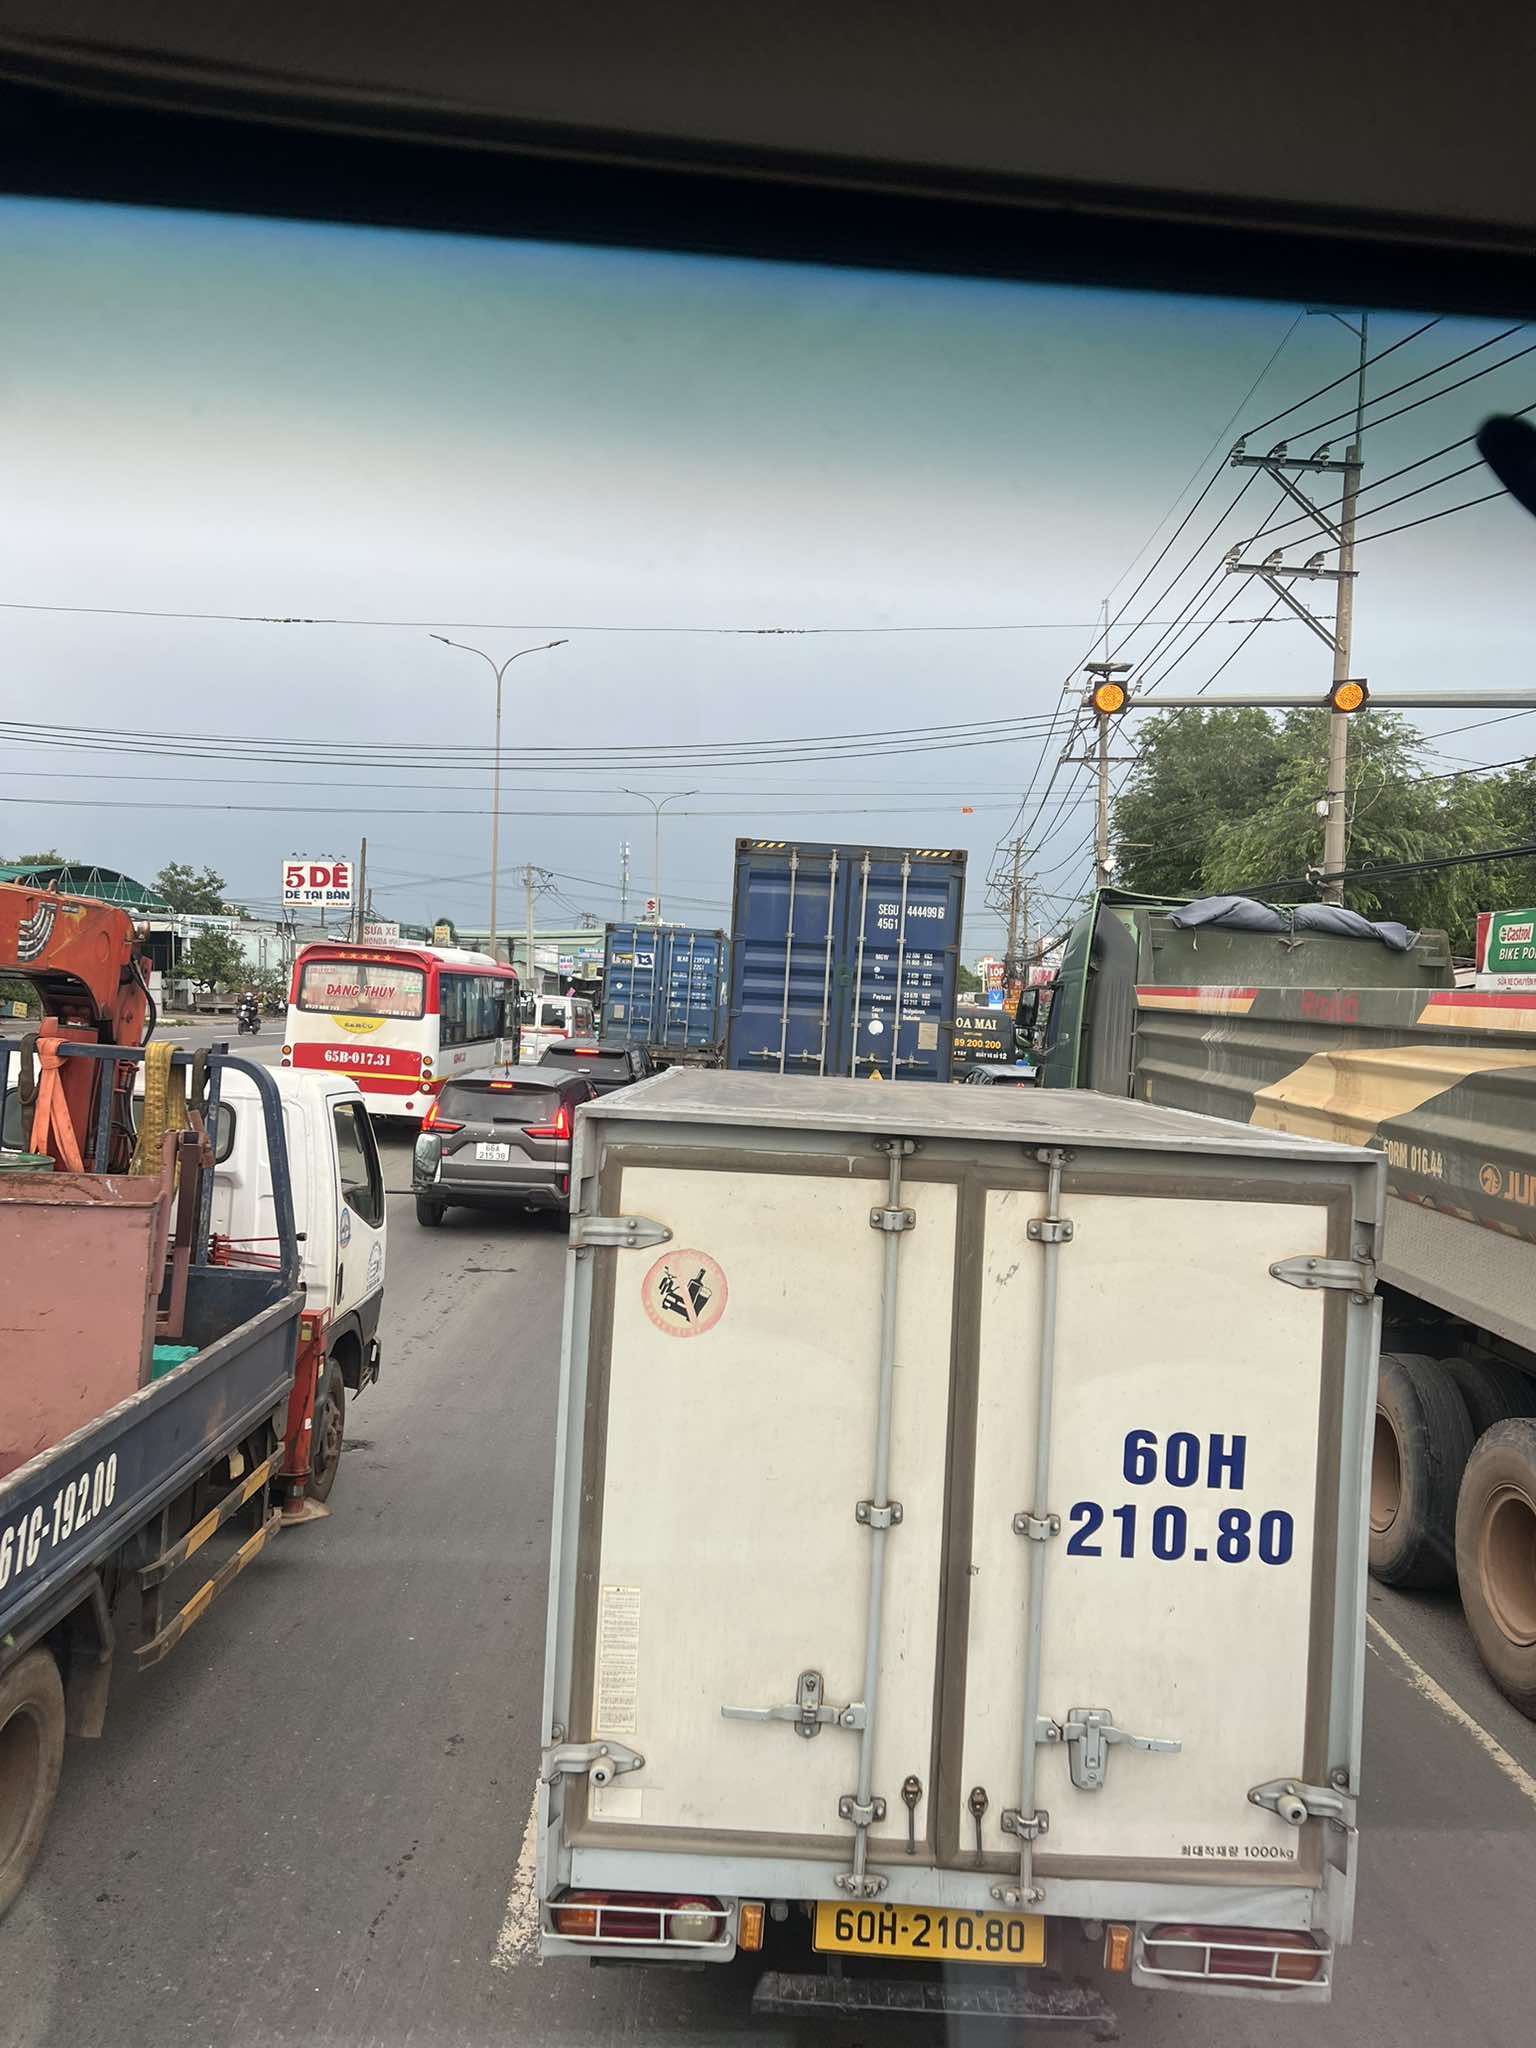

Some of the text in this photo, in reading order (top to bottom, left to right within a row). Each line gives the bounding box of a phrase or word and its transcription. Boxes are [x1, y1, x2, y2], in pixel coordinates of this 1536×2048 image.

[285, 863, 348, 888] 5 DÊ
[879, 904, 899, 916] SEGU
[878, 918, 898, 930] 45G1
[1507, 926, 1531, 941] Castrol
[1499, 947, 1536, 960] BIKE PO
[974, 1018, 997, 1030] MAI
[325, 1050, 391, 1066] 65B-017.31
[1123, 1429, 1247, 1490] 60H
[0, 1453, 117, 1590] 61C-192.00
[1067, 1501, 1294, 1565] 210.80
[1244, 1846, 1294, 1859] 1000kg
[836, 1908, 1025, 1953] 60H-210.80
